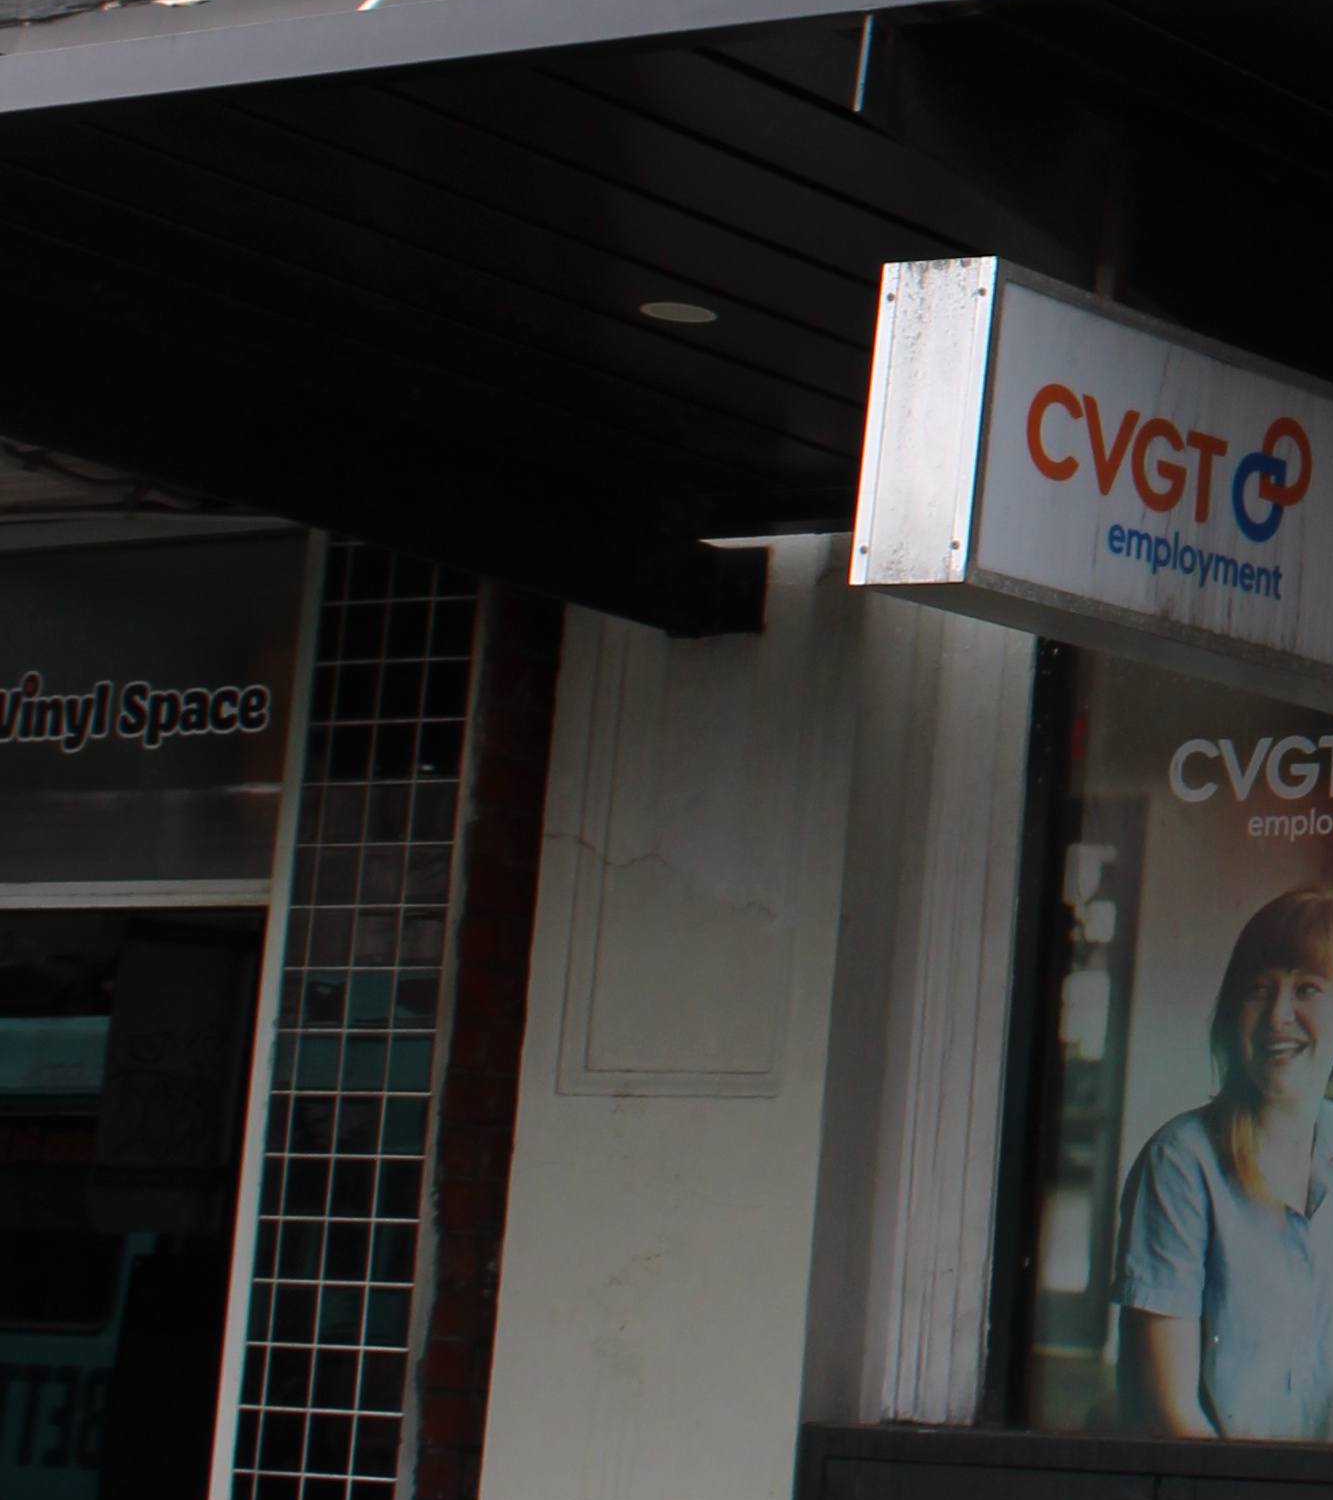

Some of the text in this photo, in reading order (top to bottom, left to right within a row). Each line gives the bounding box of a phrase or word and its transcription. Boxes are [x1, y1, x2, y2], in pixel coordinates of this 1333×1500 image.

[1026, 383, 1227, 525] CVGT
[1107, 522, 1284, 604] employment
[115, 679, 272, 750] Space
